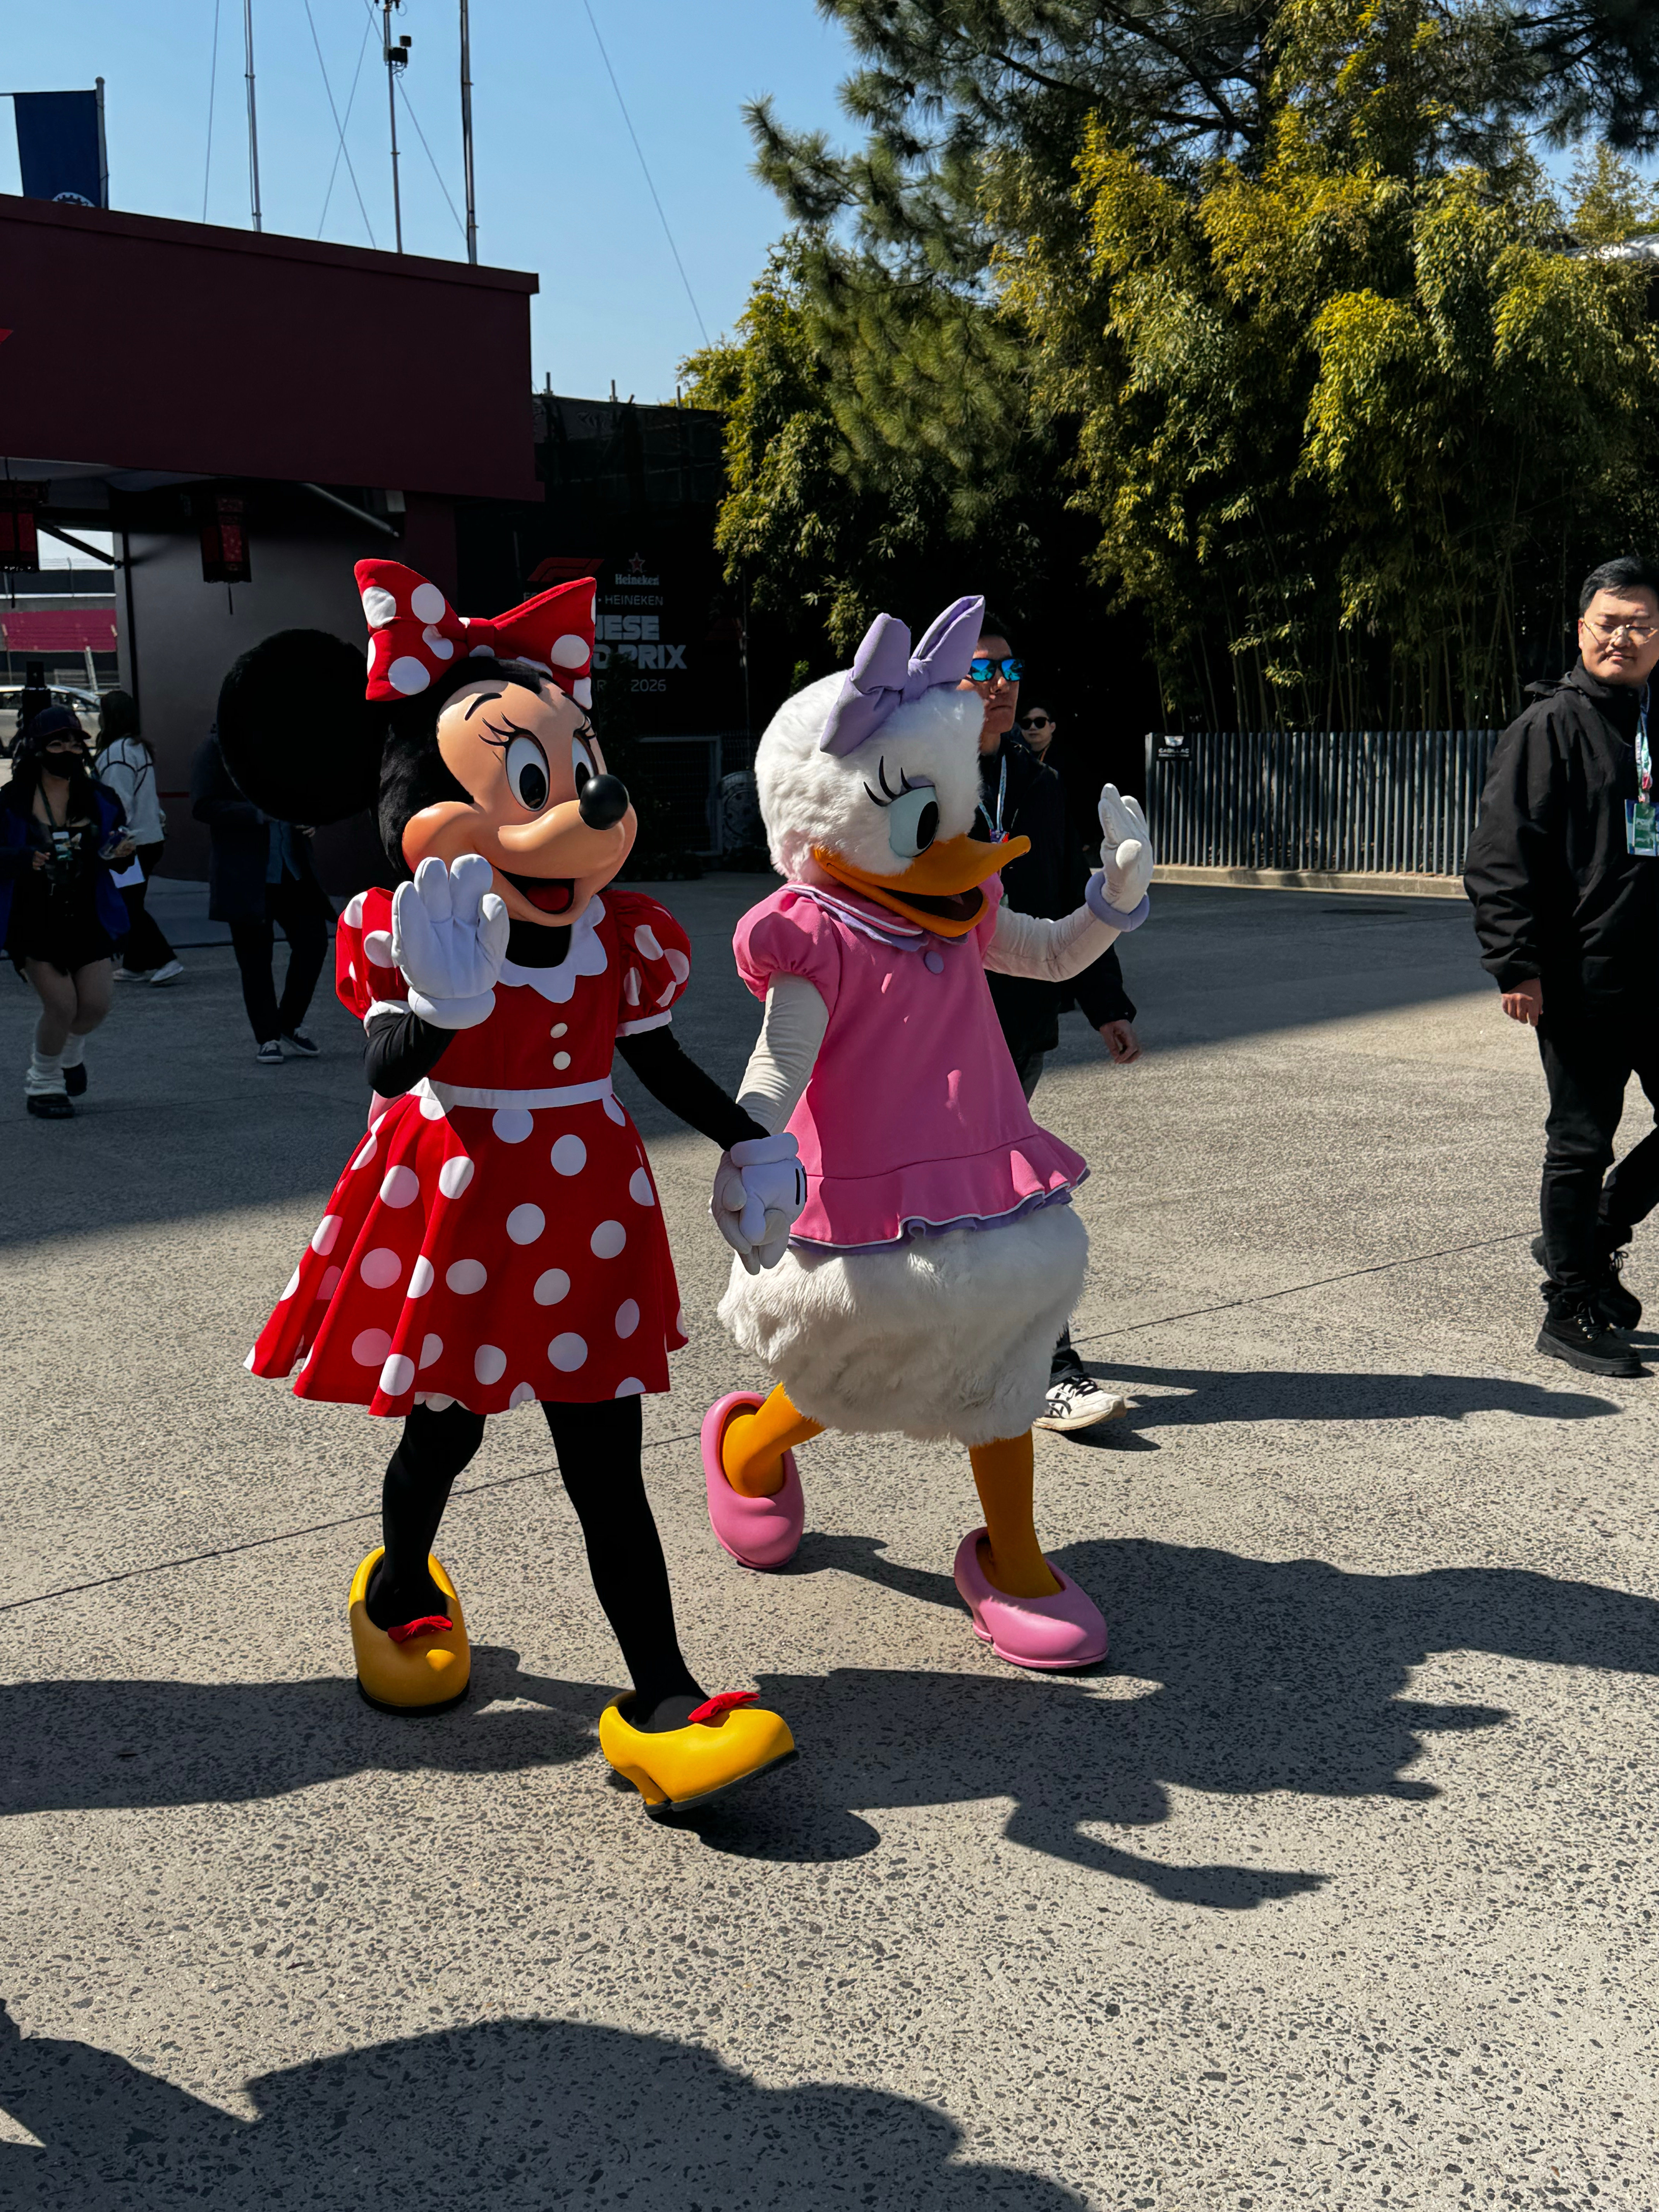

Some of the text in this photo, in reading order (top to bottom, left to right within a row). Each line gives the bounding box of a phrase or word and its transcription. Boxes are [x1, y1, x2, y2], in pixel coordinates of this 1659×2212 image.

[615, 574, 660, 586] Heineken
[605, 595, 663, 606] HEINEKEN
[618, 644, 688, 670] PRIX
[630, 679, 666, 692] 2026
